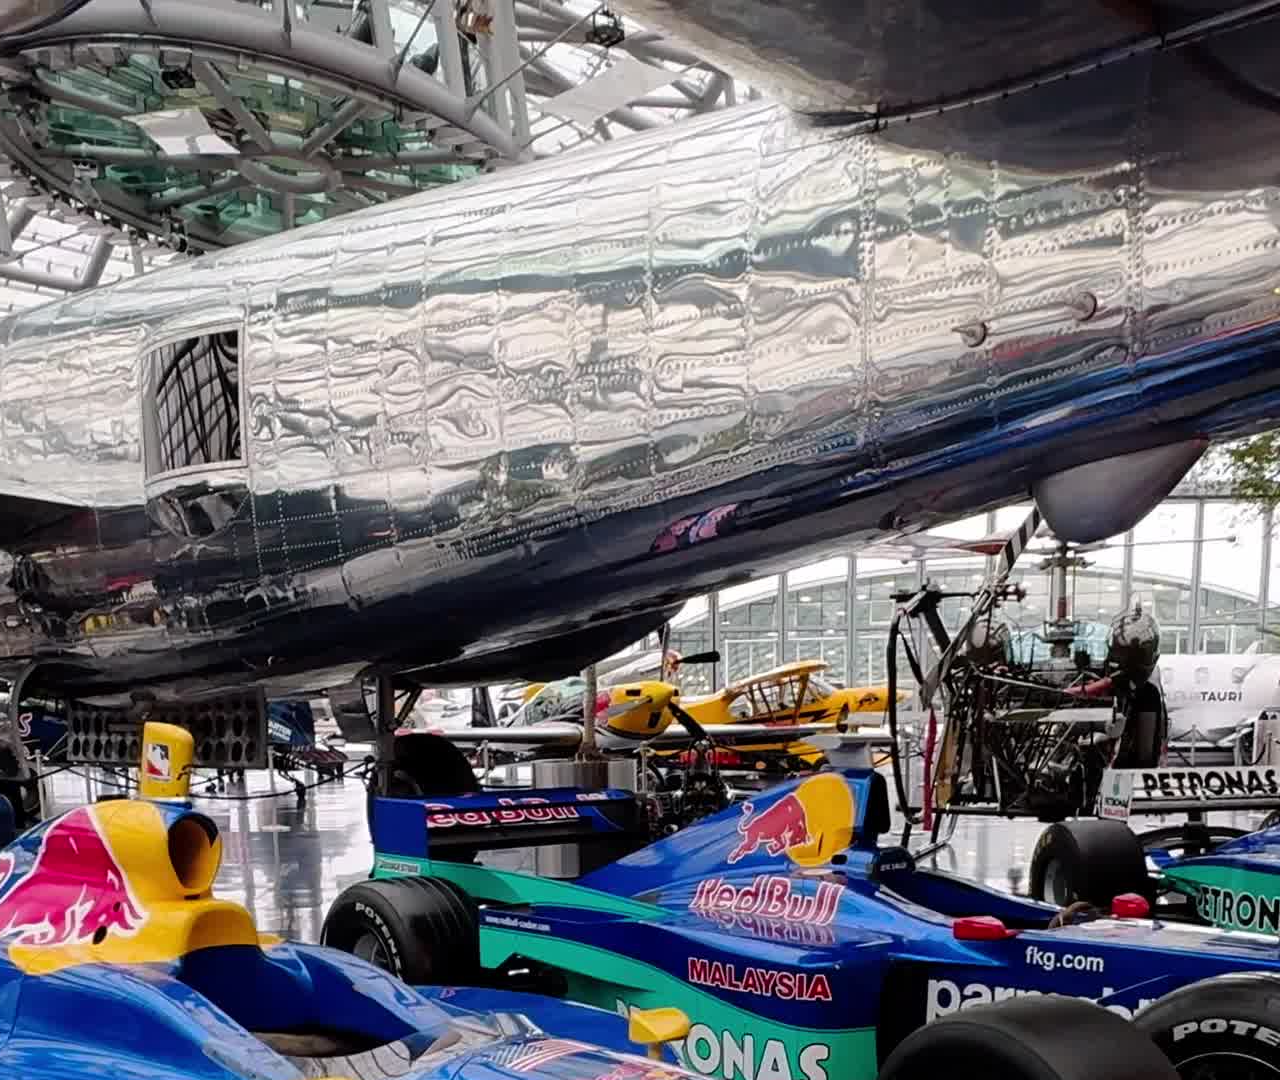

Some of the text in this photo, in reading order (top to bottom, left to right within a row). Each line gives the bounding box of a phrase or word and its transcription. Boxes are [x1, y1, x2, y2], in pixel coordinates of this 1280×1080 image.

[1141, 769, 1280, 799] PETRONAS
[1025, 946, 1105, 973] fkg.com
[688, 957, 832, 1000] MALAYSIA
